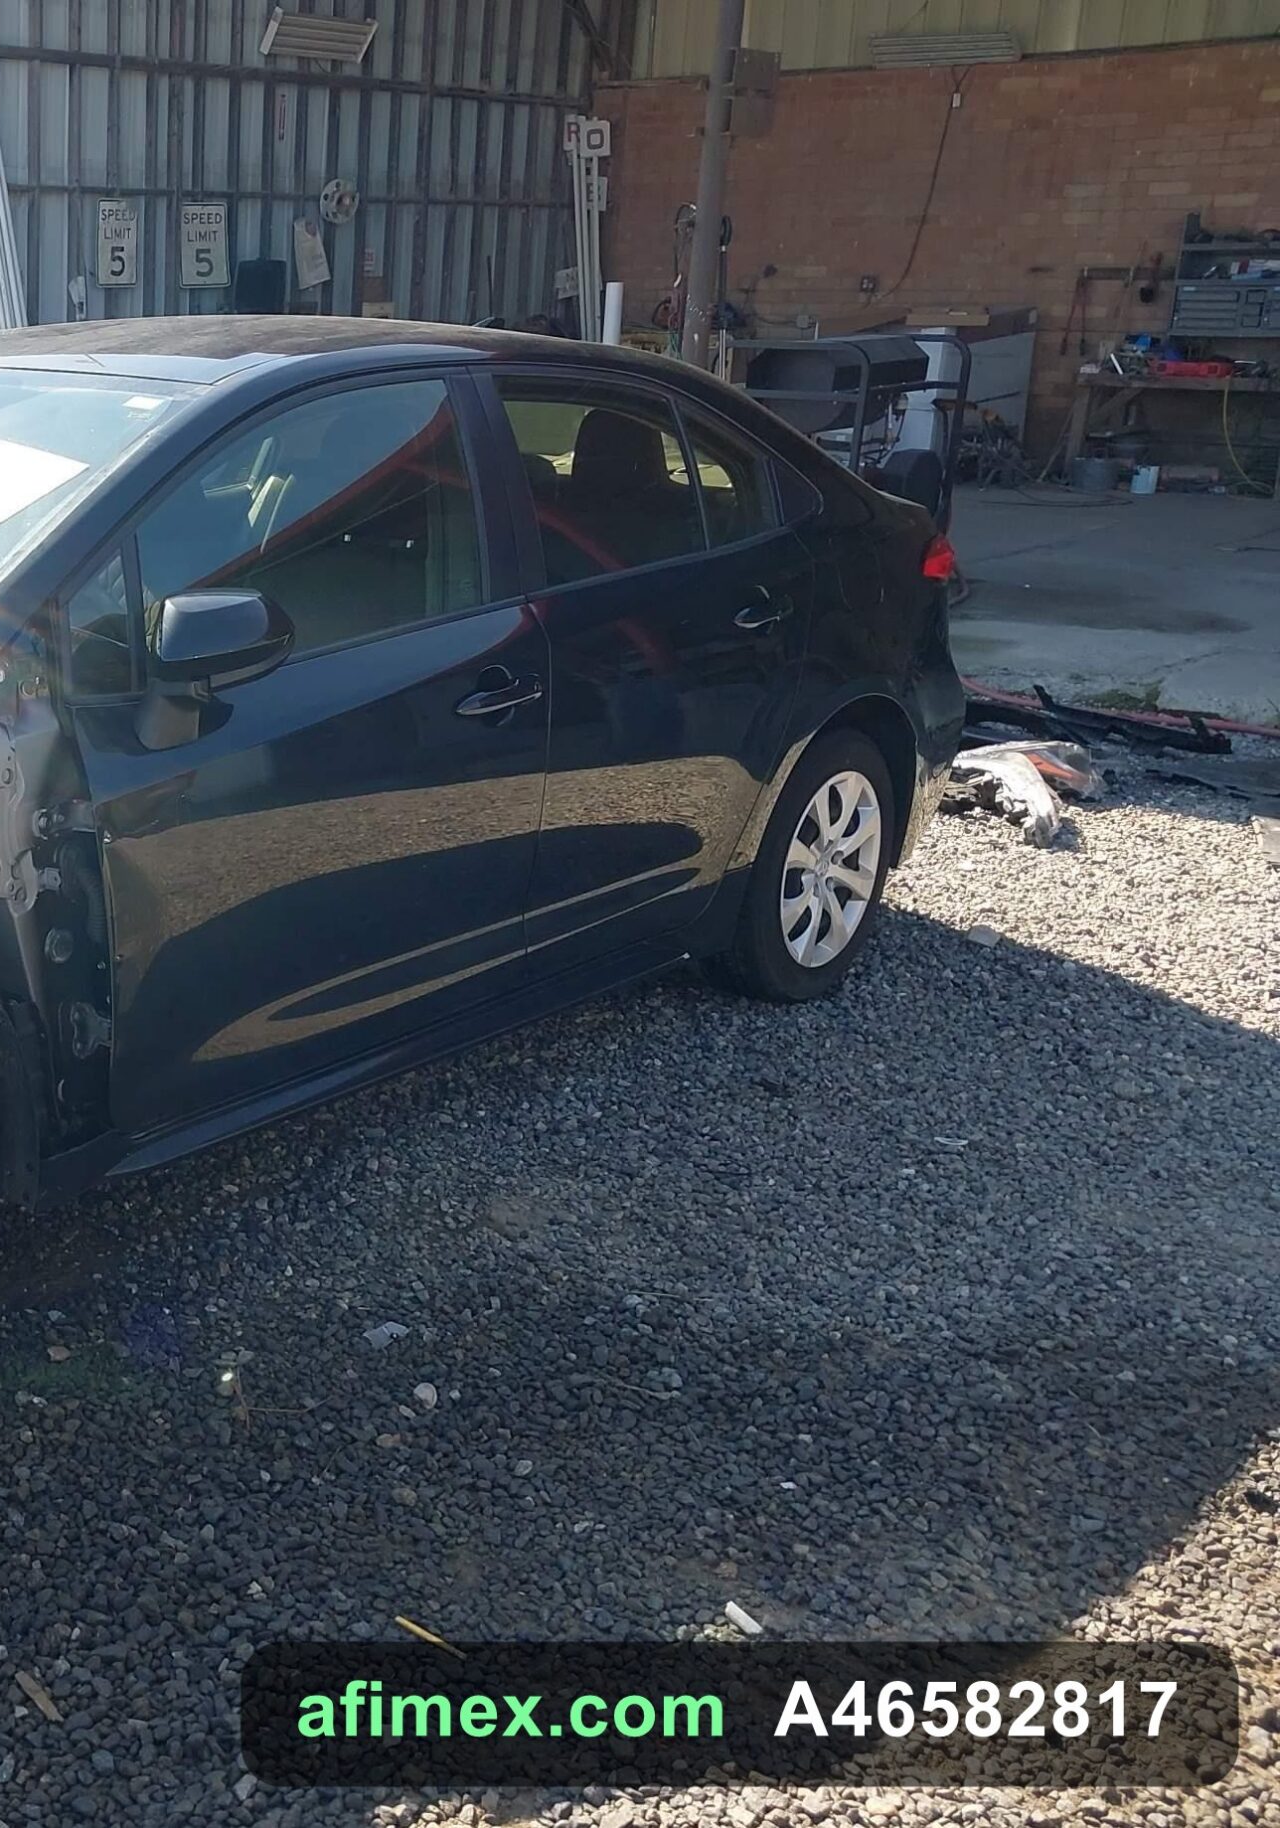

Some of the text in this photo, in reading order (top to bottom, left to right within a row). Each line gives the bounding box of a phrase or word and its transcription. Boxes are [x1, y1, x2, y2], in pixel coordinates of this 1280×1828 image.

[101, 208, 136, 222] SPEED
[183, 212, 223, 225] SPEED
[103, 227, 132, 240] LIMIT
[187, 230, 219, 243] LIMIT
[110, 246, 126, 277] 5
[195, 249, 214, 278] 5
